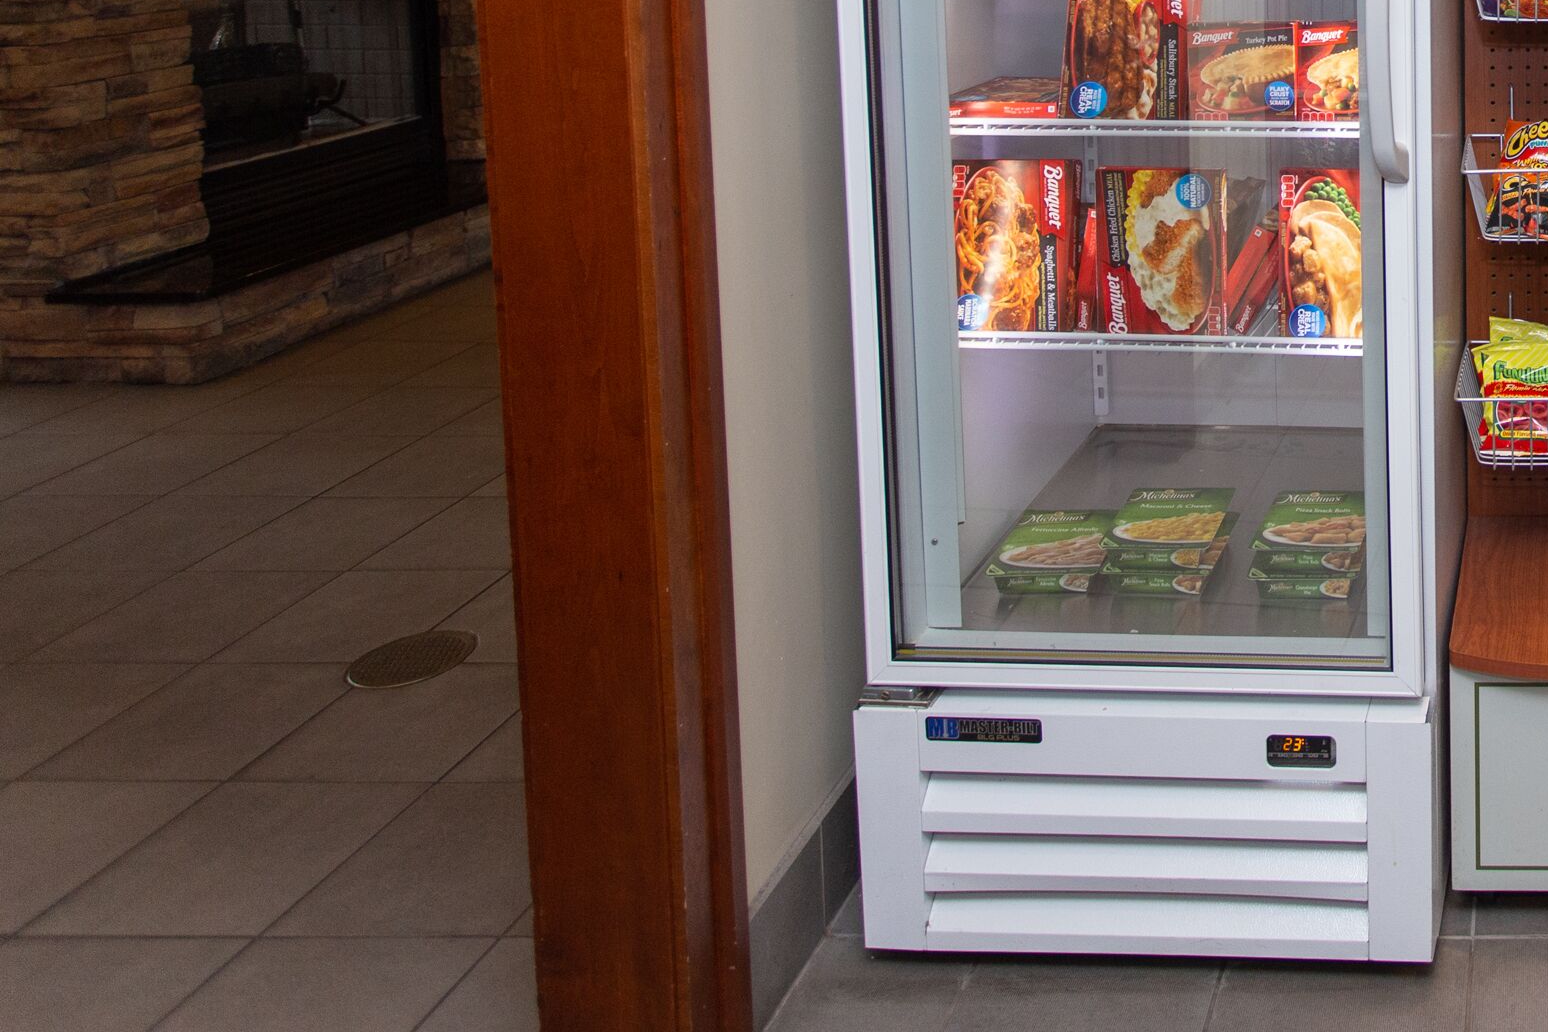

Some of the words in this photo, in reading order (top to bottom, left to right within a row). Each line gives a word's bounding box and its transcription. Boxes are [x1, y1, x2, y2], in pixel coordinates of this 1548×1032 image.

[1192, 30, 1234, 45] Banquet
[1245, 37, 1266, 45] Turkey
[1277, 35, 1288, 43] Pie
[1301, 29, 1344, 44] Banquet
[1166, 39, 1177, 75] Salisbury
[1077, 86, 1087, 114] CREAM
[1167, 78, 1177, 100] Steak
[1084, 89, 1093, 112] REAL
[1106, 173, 1114, 188] MEAL
[1189, 175, 1197, 208] NATURAL
[1043, 164, 1063, 230] Banquet
[1106, 190, 1116, 217] Chicken
[1107, 217, 1118, 234] Fried
[1109, 235, 1120, 262] Chicken
[1044, 245, 1055, 281] Spaghetti
[1046, 291, 1056, 331] Meatballs
[1108, 272, 1128, 334] Banquet
[1297, 308, 1305, 337] CREAM
[1129, 491, 1195, 501] Michelina's
[1275, 494, 1341, 504] Michelina's
[1020, 513, 1085, 525] Michelina's
[928, 718, 959, 738] MB
[960, 719, 1040, 735] MASTER-BILT
[1283, 737, 1302, 752] 23
